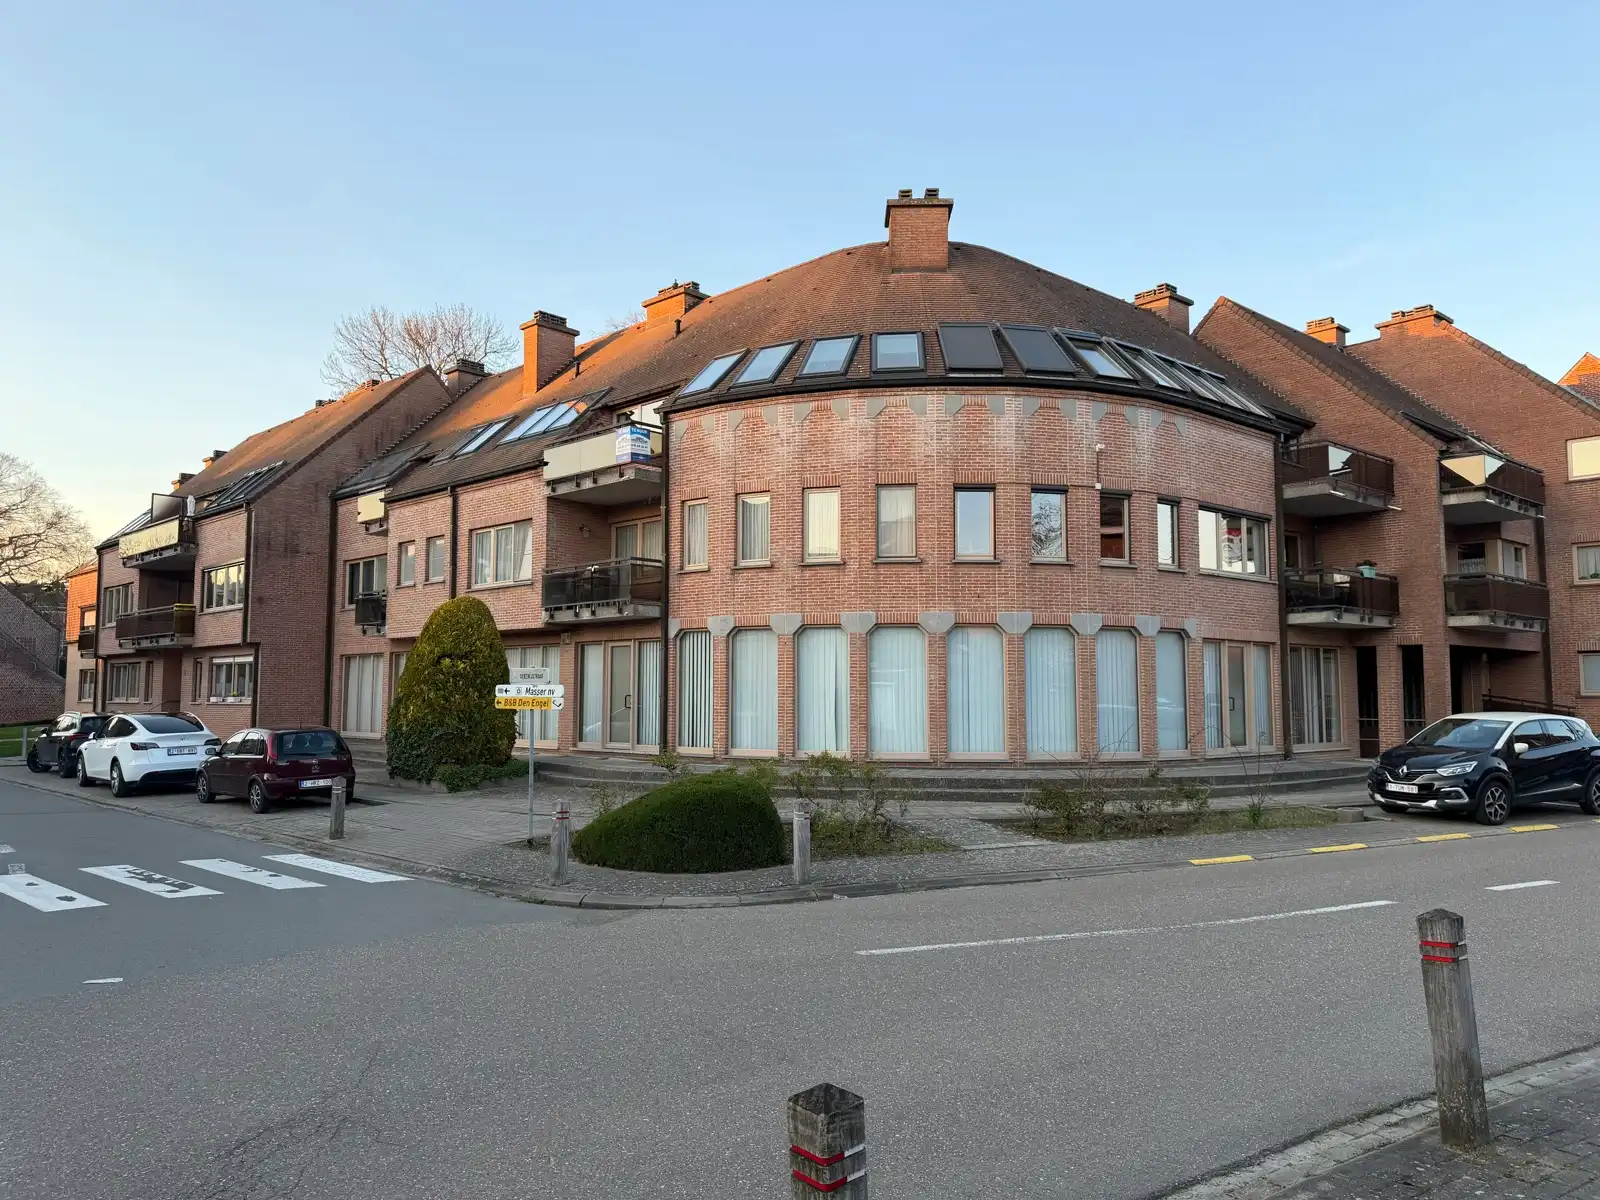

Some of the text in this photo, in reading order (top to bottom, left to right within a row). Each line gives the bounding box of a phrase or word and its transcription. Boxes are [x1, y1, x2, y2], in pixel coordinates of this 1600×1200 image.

[525, 687, 547, 696] Masser
[503, 699, 550, 709] B&B Den Engel
